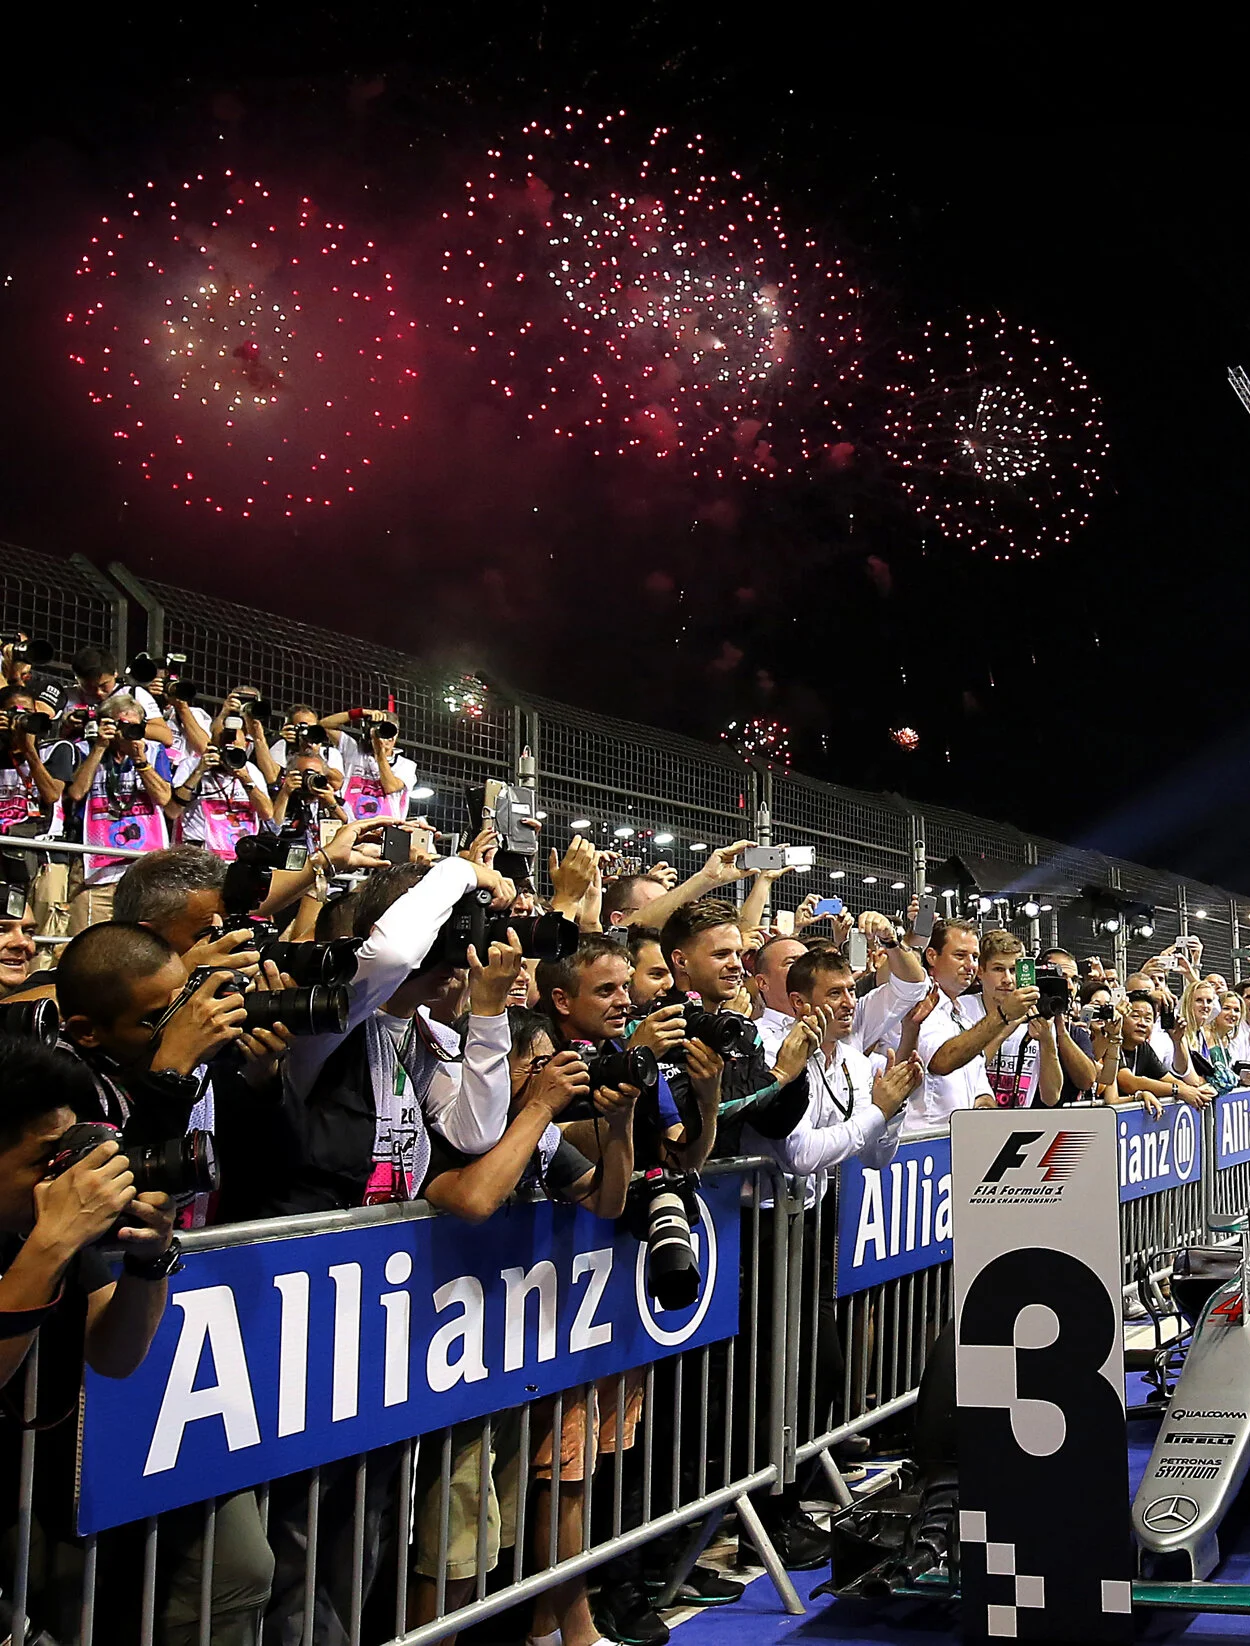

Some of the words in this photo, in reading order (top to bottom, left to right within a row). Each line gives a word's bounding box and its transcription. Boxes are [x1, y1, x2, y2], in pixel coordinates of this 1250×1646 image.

[980, 1130, 1099, 1183] F1
[1119, 1121, 1170, 1187] ianz
[974, 1185, 998, 1196] FIA
[1000, 1185, 1054, 1196] Formula
[1055, 1185, 1065, 1196] 1
[852, 1155, 953, 1268] Allia
[144, 1251, 613, 1477] Allianz
[958, 1247, 1126, 1511] 3
[1171, 1409, 1247, 1420] QUALCOMM
[1164, 1432, 1236, 1446] PIRELLI
[1155, 1465, 1220, 1480] SYNTIUM
[1160, 1457, 1222, 1466] PETRONAS
